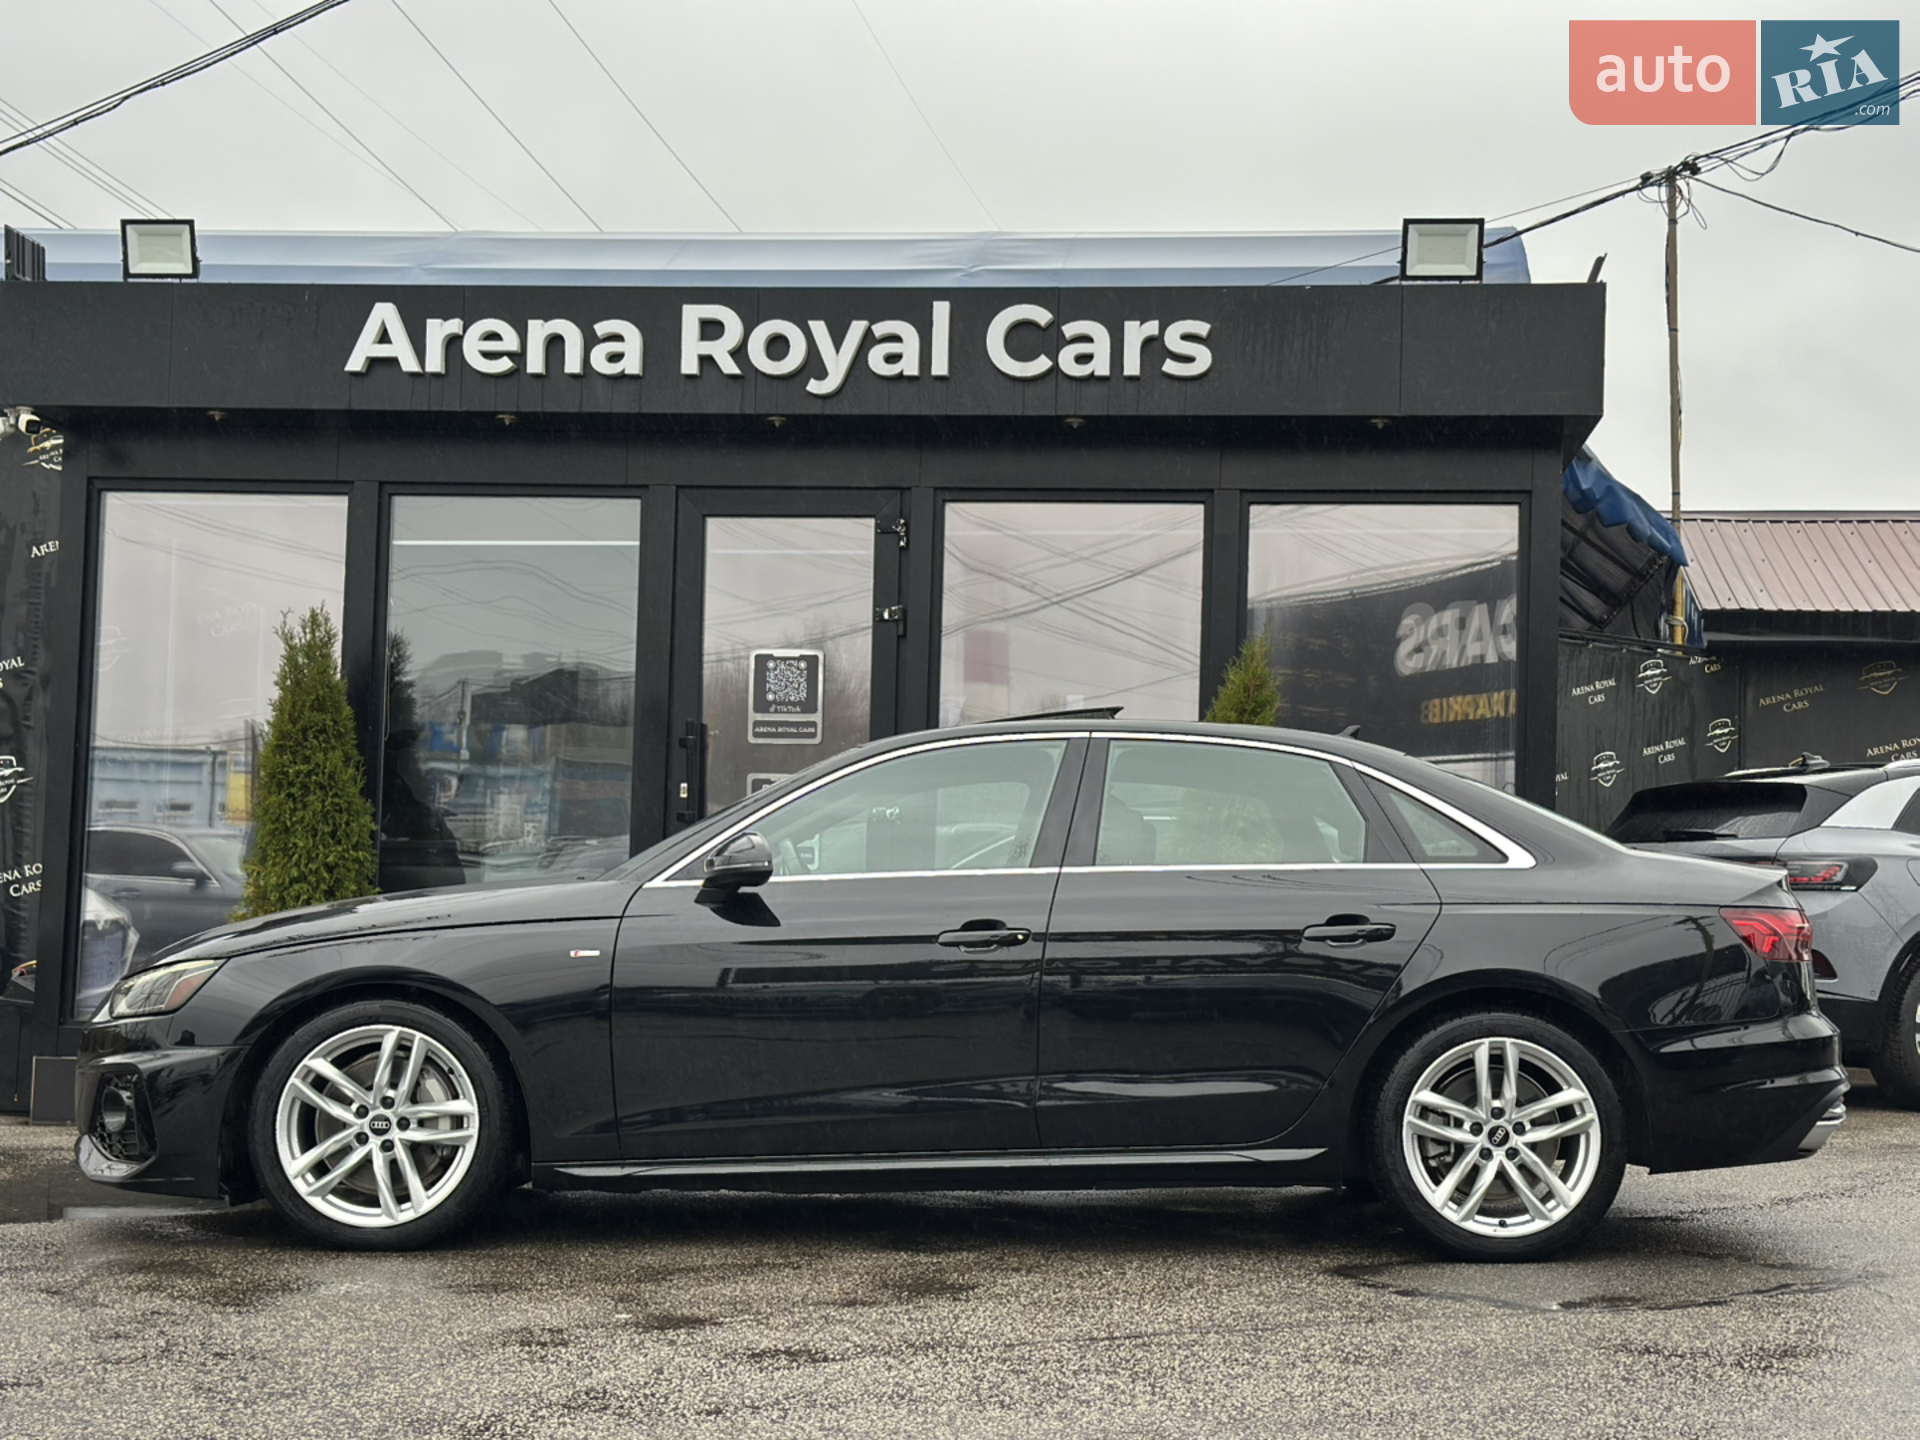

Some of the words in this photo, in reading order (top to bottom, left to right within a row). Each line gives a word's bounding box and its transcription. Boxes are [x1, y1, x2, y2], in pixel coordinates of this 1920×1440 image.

[344, 301, 644, 377] Arena
[680, 301, 951, 397] Royal
[986, 303, 1212, 381] Cars
[1759, 692, 1792, 707] ARENA
[1793, 684, 1825, 698] ROYAL
[1783, 700, 1809, 712] CARS
[1866, 742, 1900, 757] ARENA
